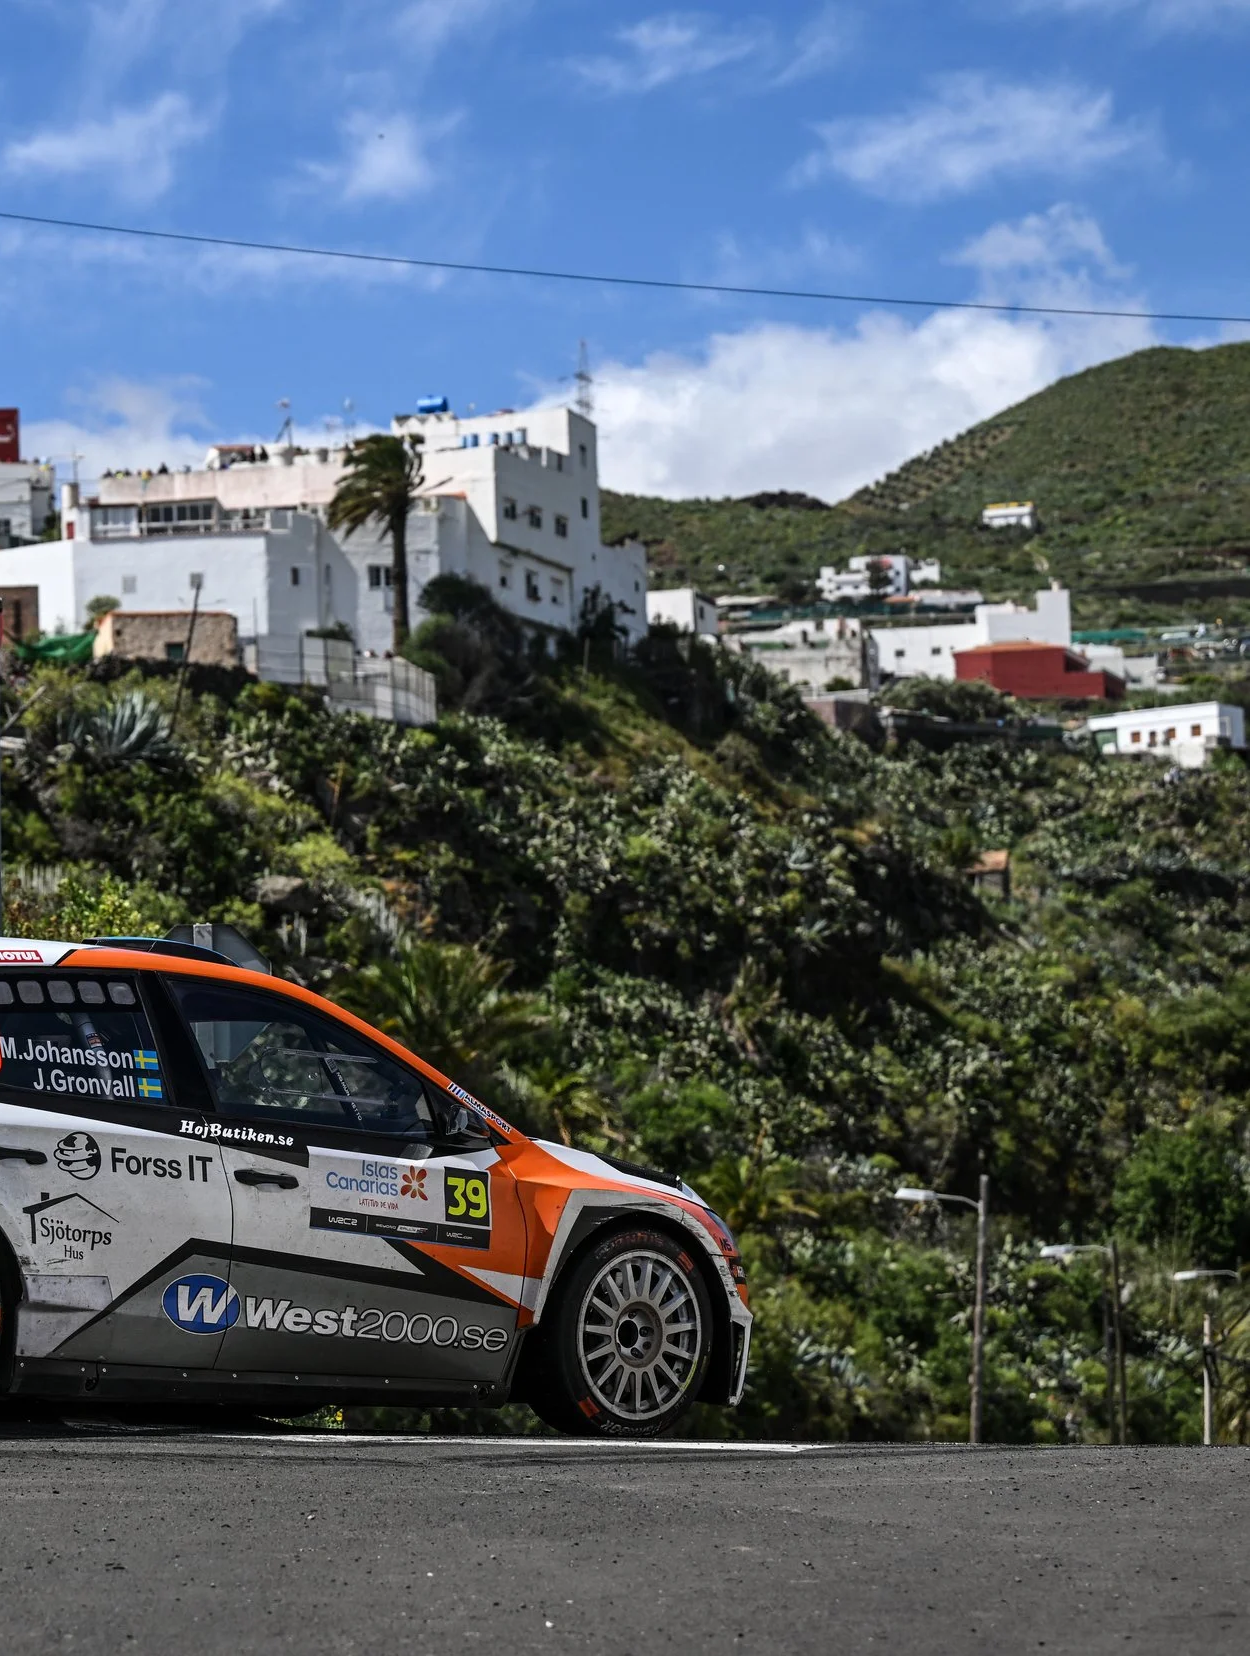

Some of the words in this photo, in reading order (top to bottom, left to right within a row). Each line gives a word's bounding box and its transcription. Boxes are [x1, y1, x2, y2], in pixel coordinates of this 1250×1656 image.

[0, 1036, 134, 1069] M.Johansson
[33, 1068, 136, 1098] J.Gronvall
[179, 1120, 295, 1147] HojButiken.se
[111, 1147, 182, 1179] Forss
[188, 1155, 213, 1182] IT
[362, 1159, 398, 1180] Islas
[326, 1171, 398, 1197] Canarias
[447, 1176, 488, 1219] 39
[358, 1198, 379, 1208] LATITUD
[387, 1202, 399, 1210] VIDA
[40, 1217, 112, 1251] Sjötorps
[328, 1215, 358, 1226] WRC2
[64, 1245, 84, 1260] Hus
[244, 1295, 510, 1351] West2000.se
